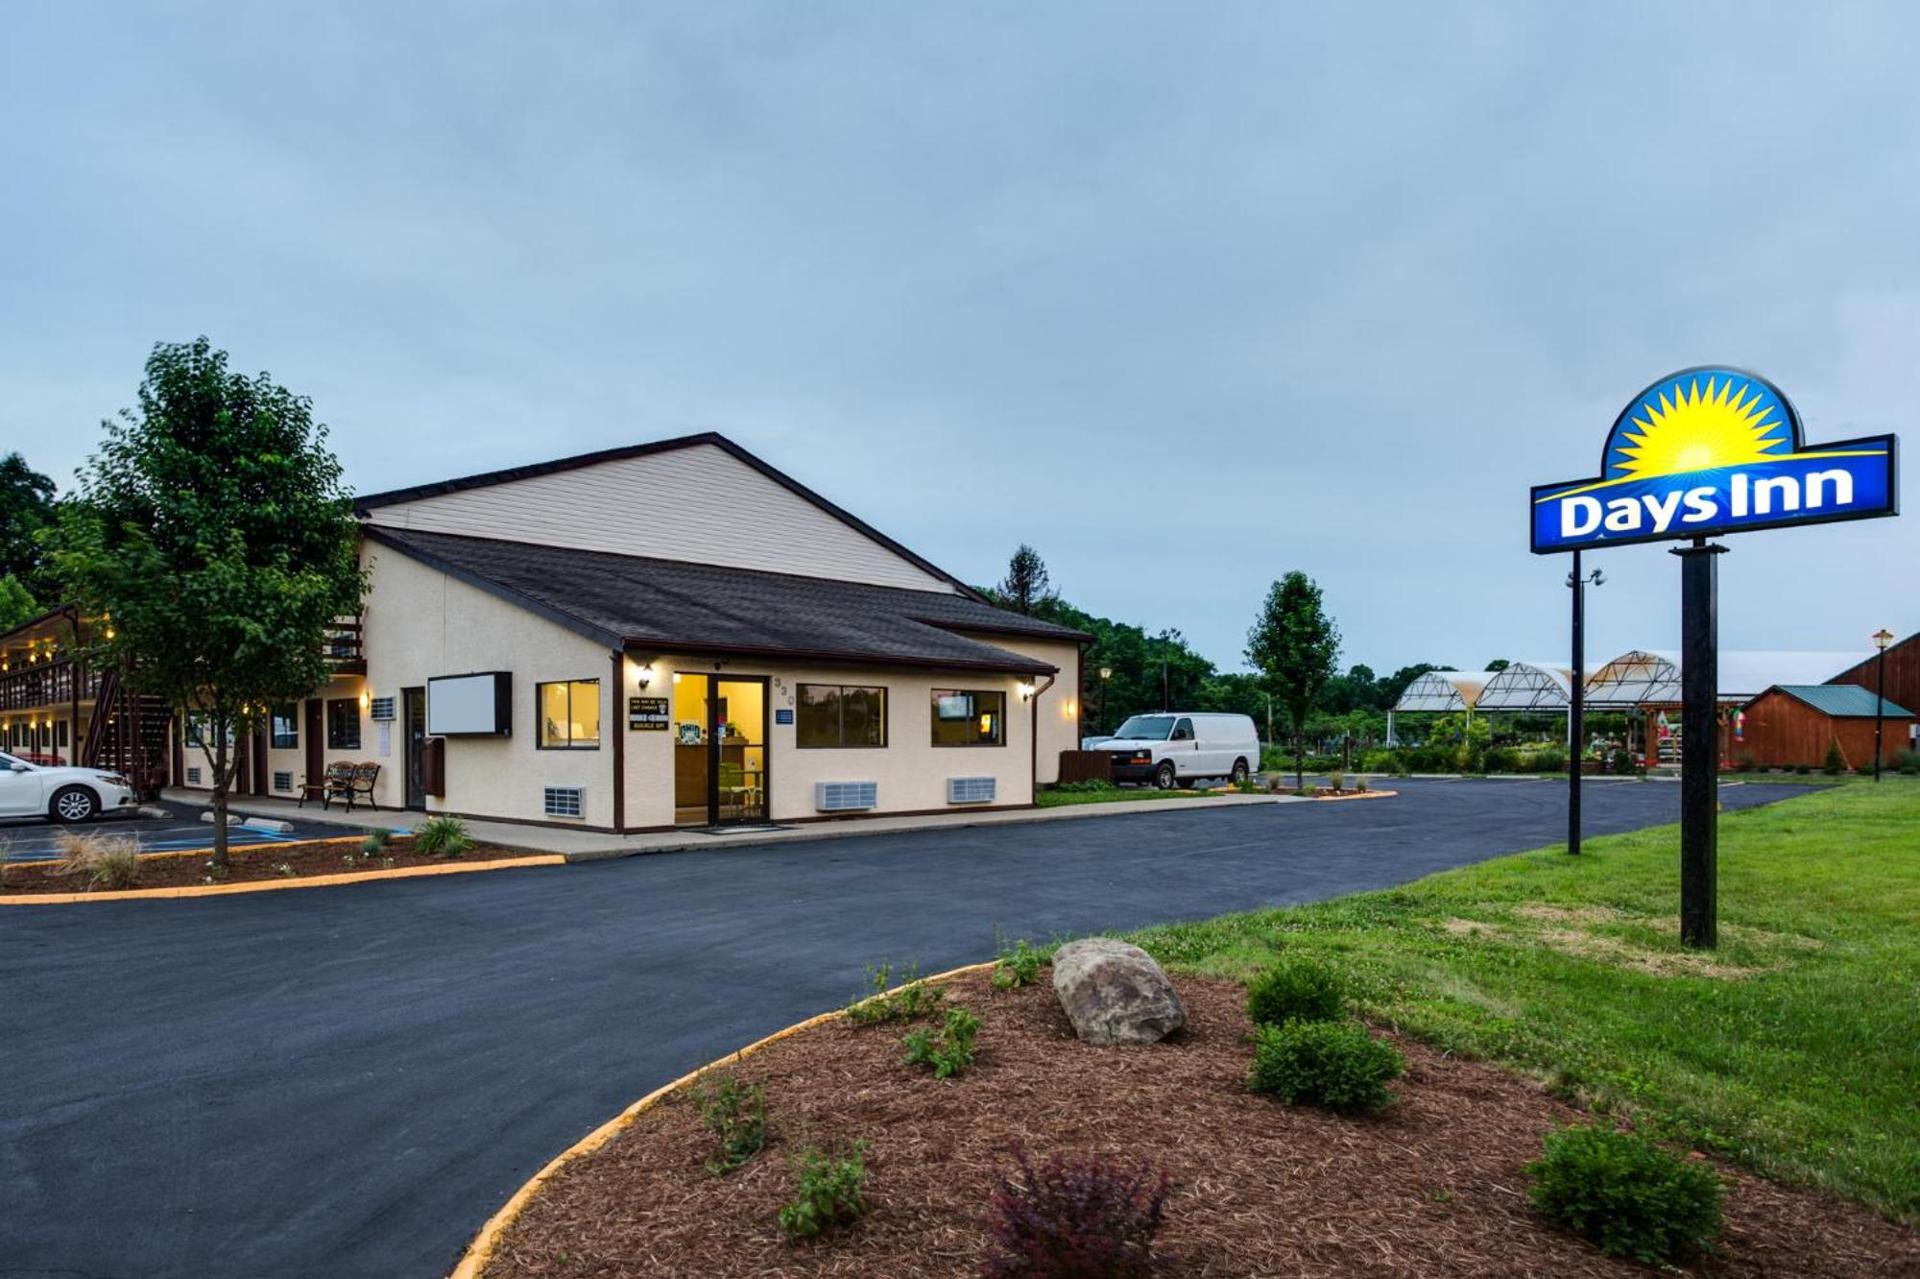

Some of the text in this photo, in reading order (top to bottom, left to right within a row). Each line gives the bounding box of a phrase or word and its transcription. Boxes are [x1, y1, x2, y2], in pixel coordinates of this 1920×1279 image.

[1561, 469, 1853, 537] Days Inn
[774, 677, 794, 706] 330
